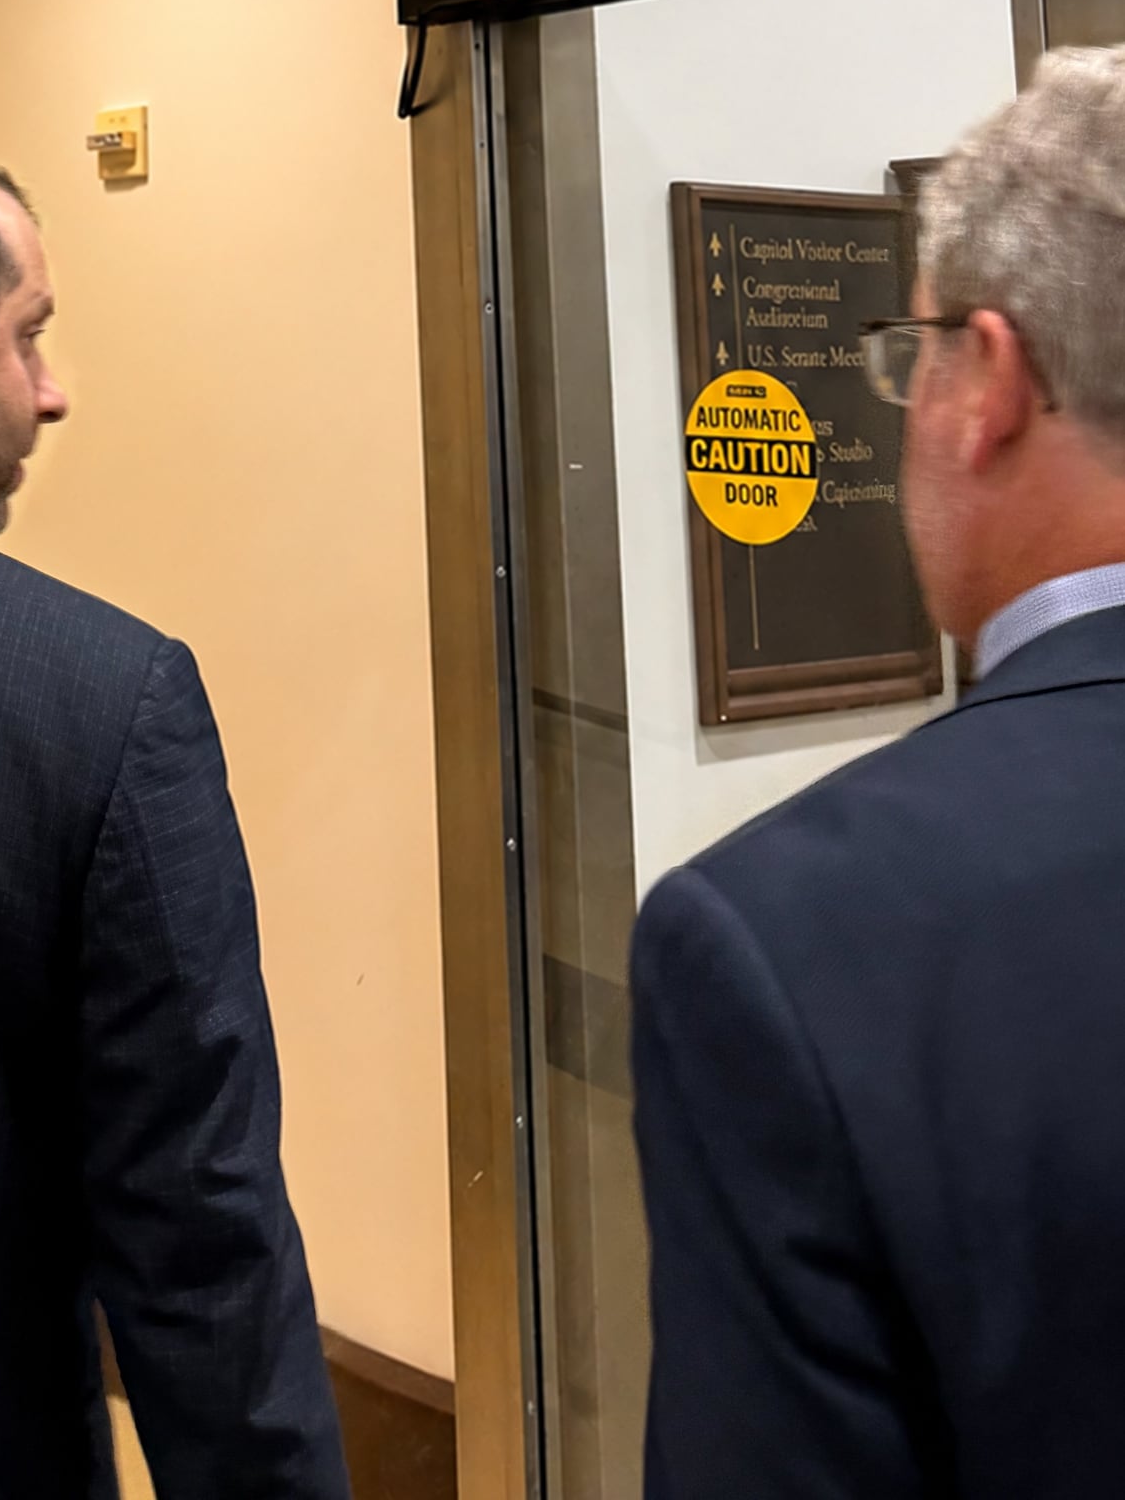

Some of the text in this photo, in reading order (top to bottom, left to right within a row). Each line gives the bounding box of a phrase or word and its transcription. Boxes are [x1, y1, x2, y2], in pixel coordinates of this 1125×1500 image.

[739, 236, 890, 265] Capitol Visitor Center
[742, 275, 841, 304] Congressional
[746, 306, 829, 329] Auditorium
[747, 344, 778, 368] U.S.
[781, 345, 827, 368] Senate
[696, 406, 801, 432] AUTOMATIC
[691, 438, 811, 476] CAUTION
[829, 437, 873, 462] Studio
[725, 481, 778, 507] DOOR
